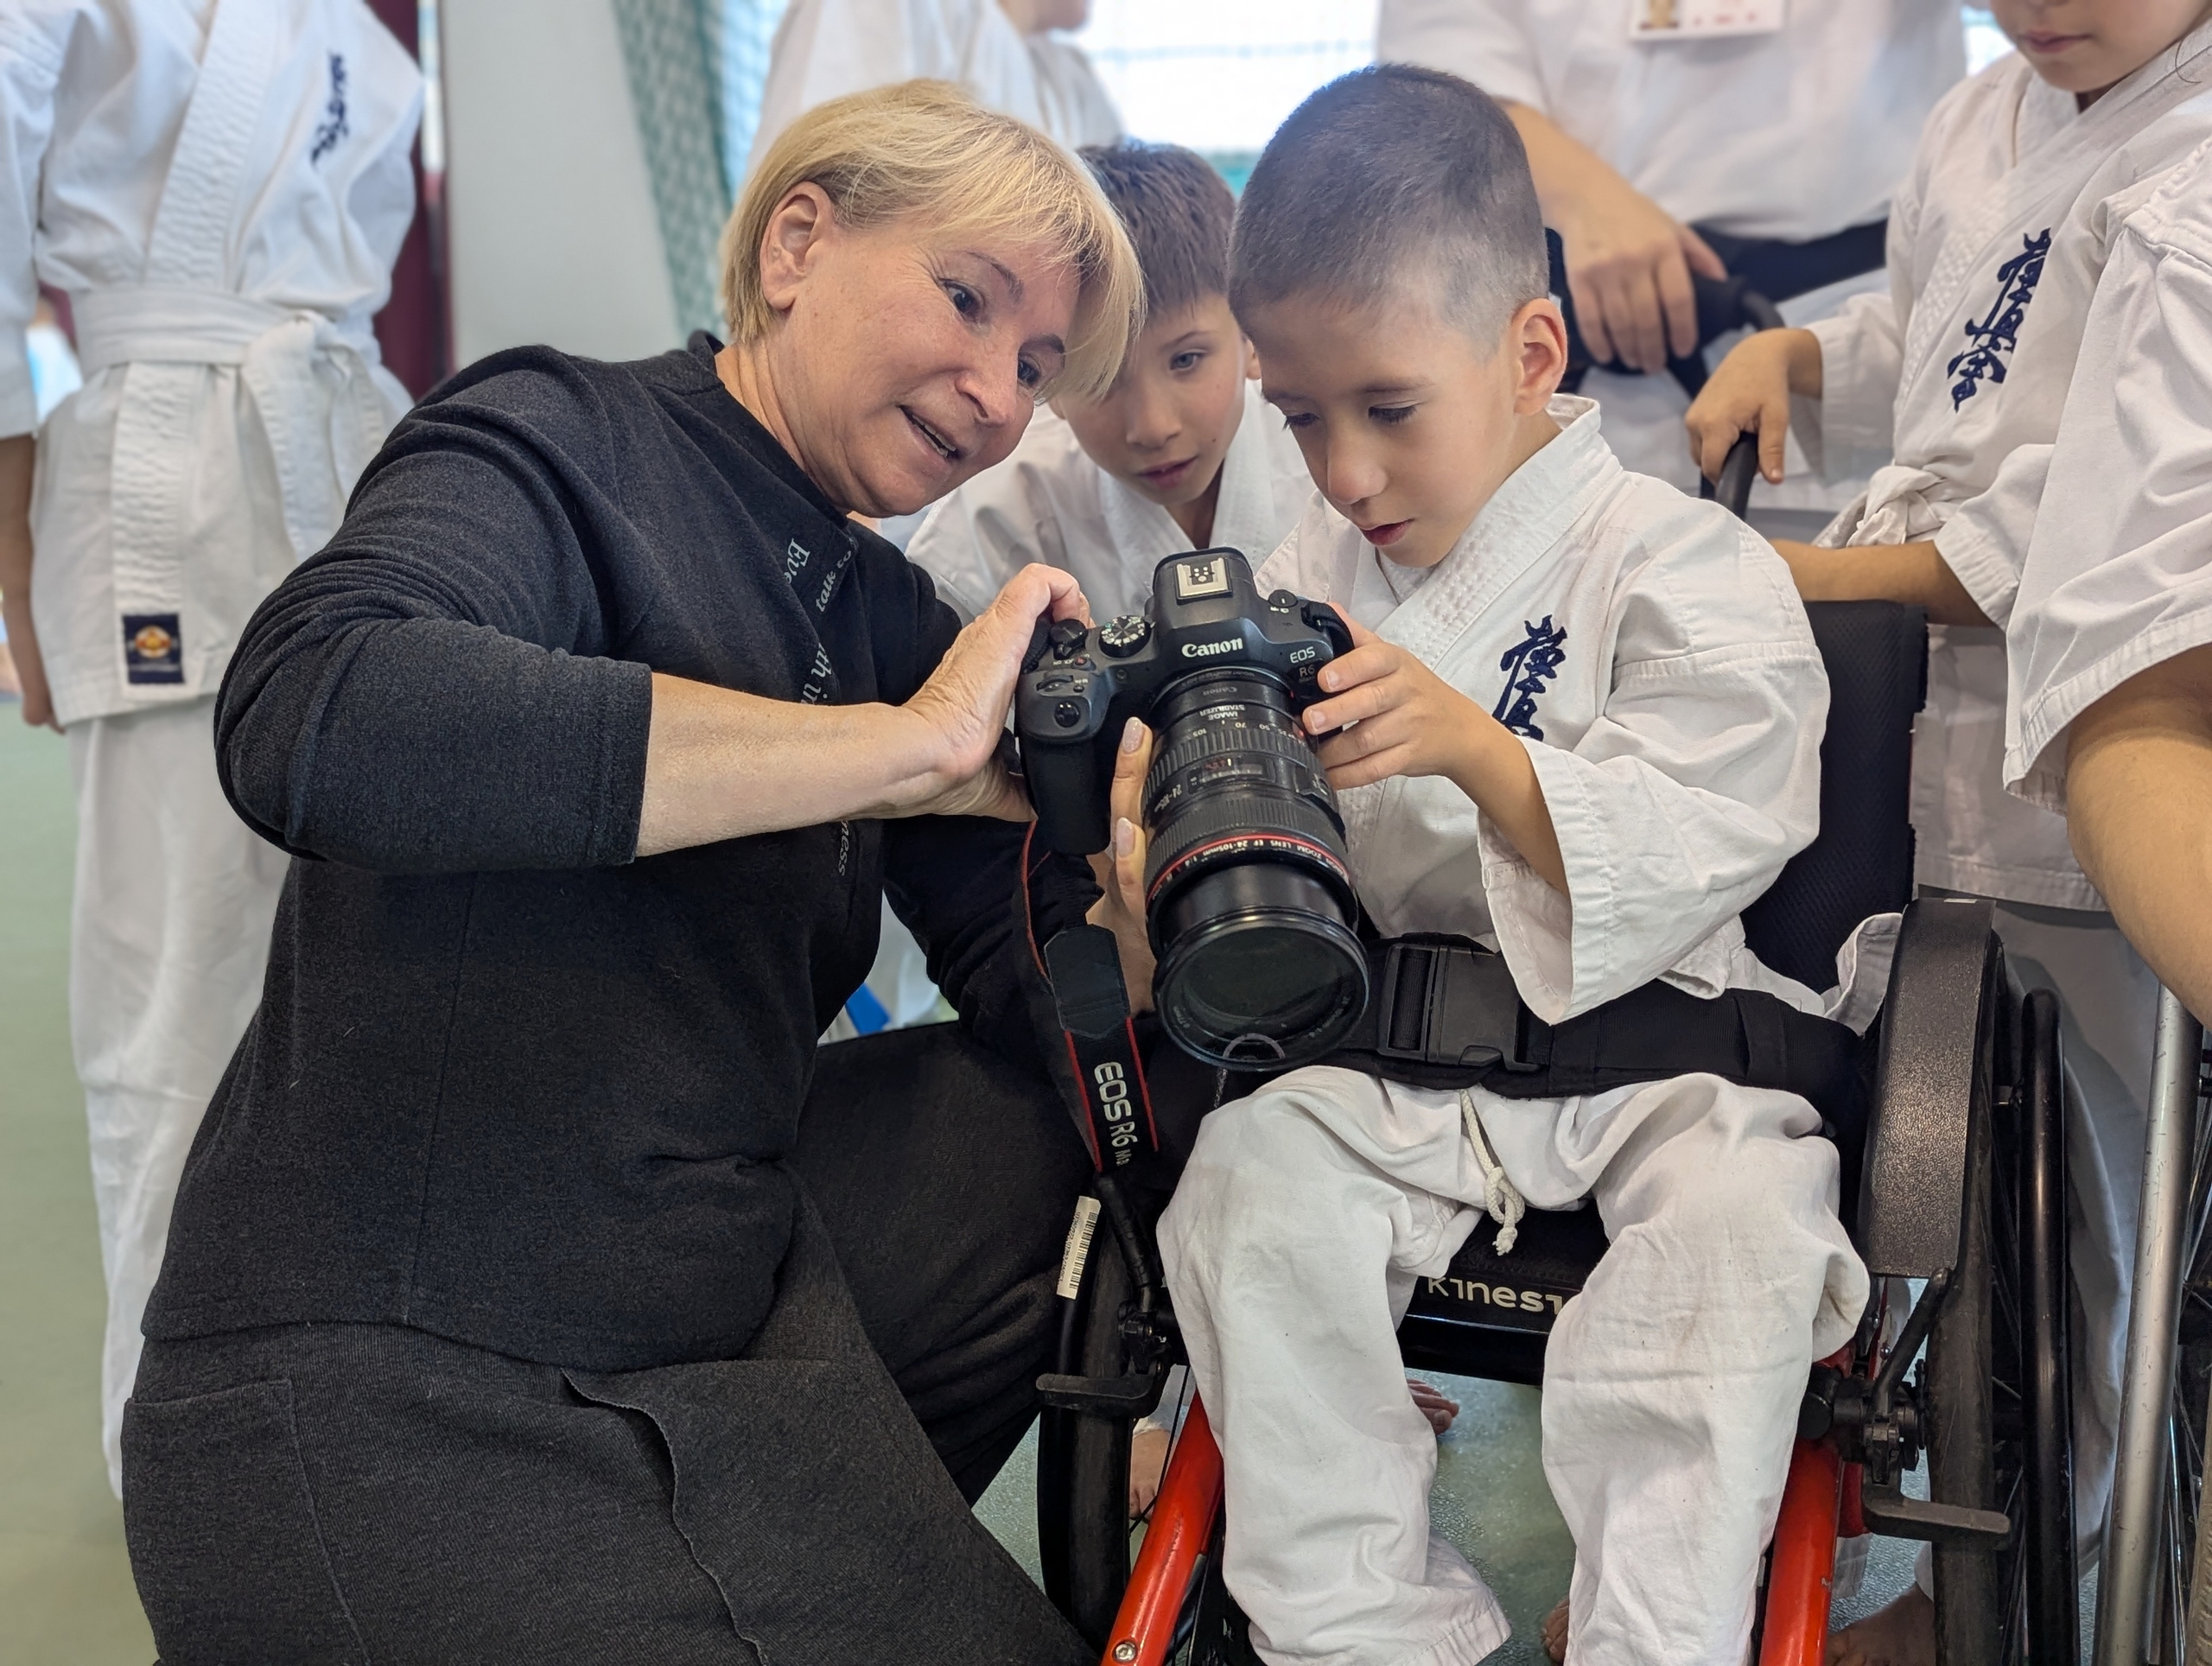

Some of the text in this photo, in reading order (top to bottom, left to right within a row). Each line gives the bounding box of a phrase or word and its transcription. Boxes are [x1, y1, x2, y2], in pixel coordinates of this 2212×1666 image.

[816, 550, 852, 612] talk to
[1182, 638, 1243, 658] Canon
[1290, 646, 1316, 664] EOS
[1299, 664, 1315, 677] R6
[1203, 686, 1238, 696] Canon
[1199, 704, 1245, 717] STABILIZER
[1208, 711, 1238, 721] IMAGE
[1192, 728, 1206, 738] 105
[1270, 839, 1292, 849] LENS
[1296, 844, 1322, 859] ZOOM
[1094, 1061, 1132, 1122] EOS
[1109, 1121, 1138, 1148] R6
